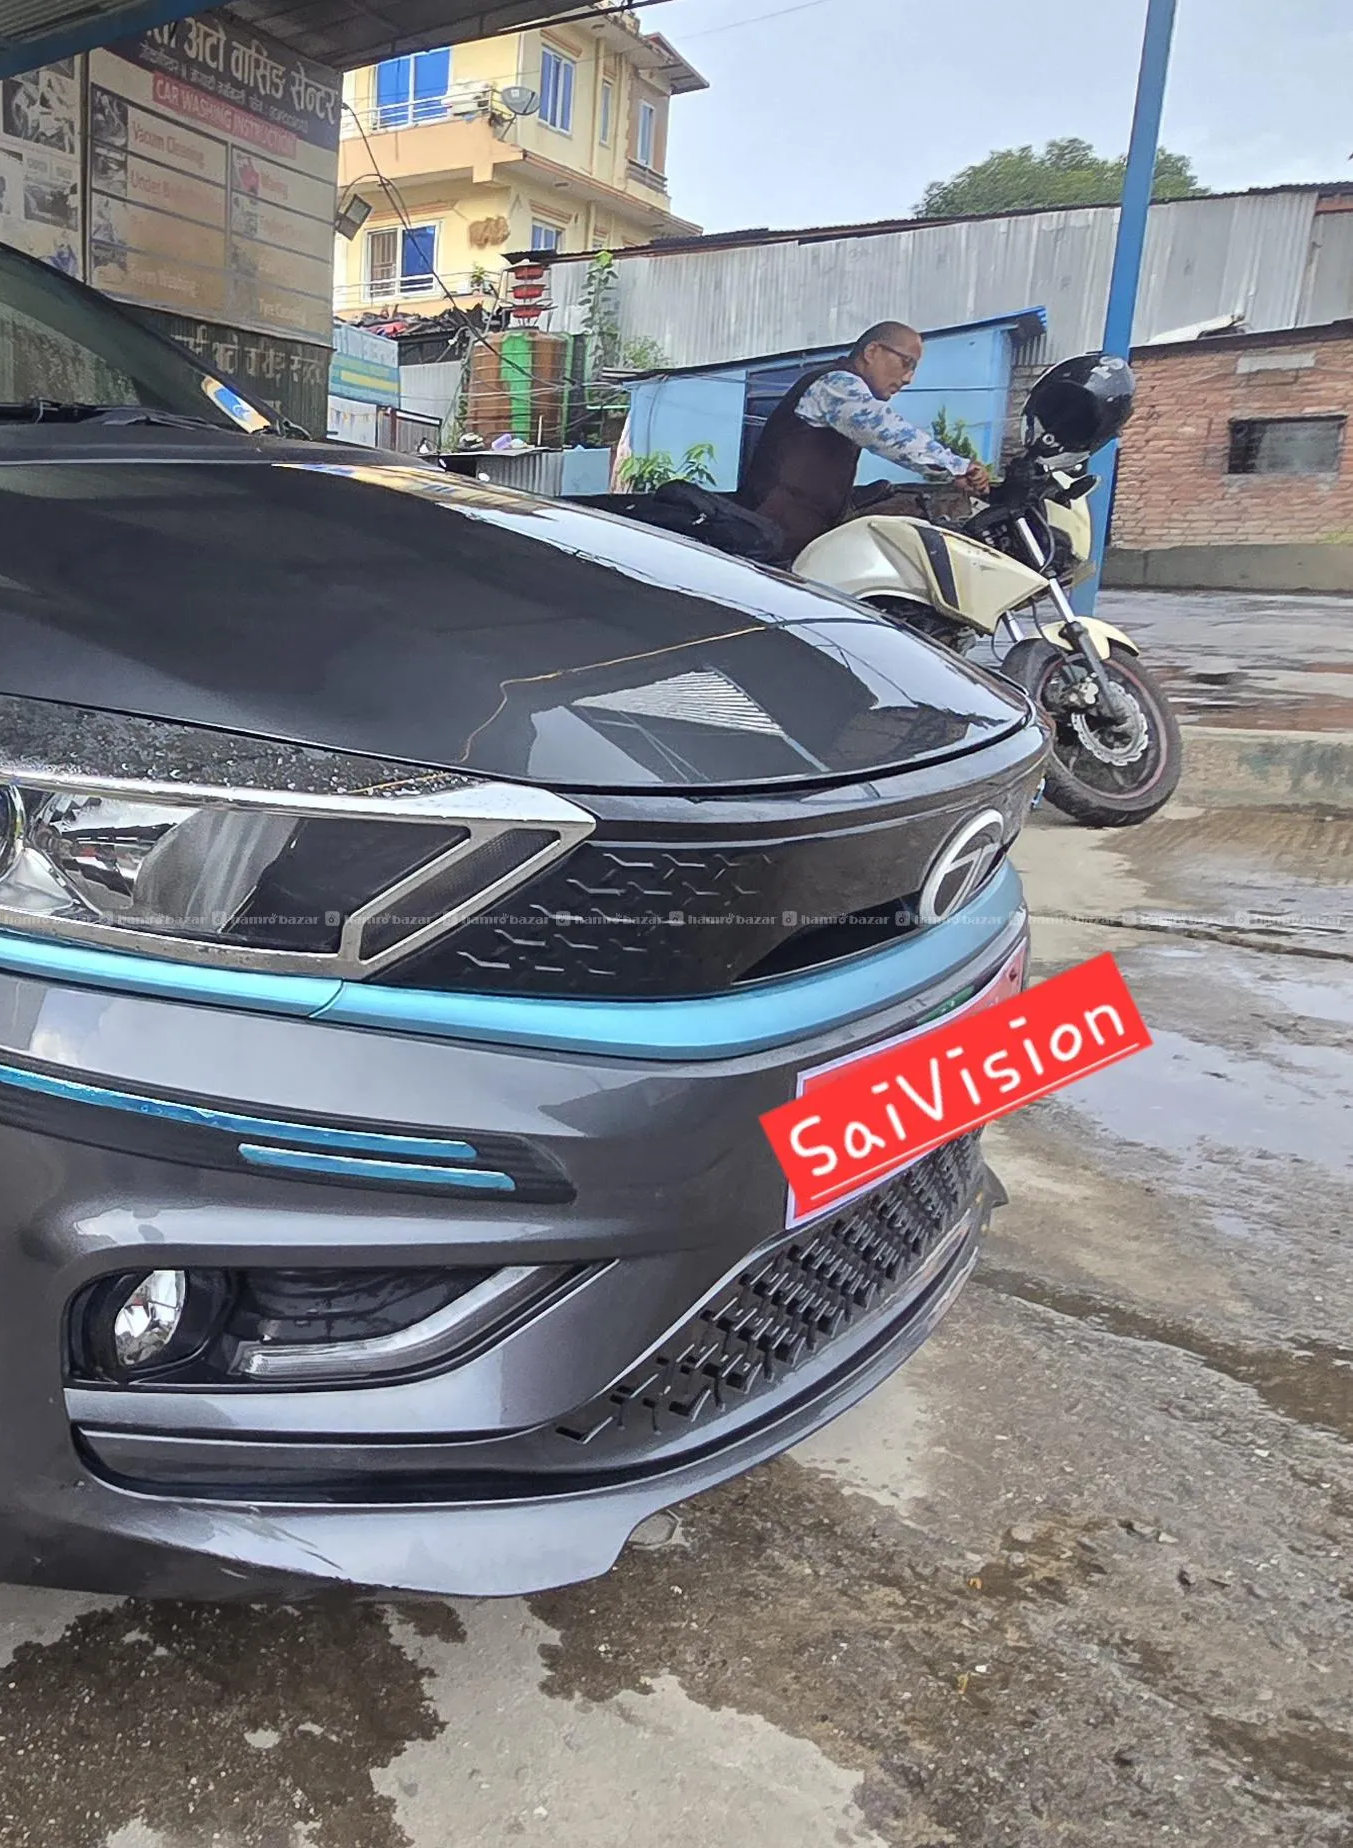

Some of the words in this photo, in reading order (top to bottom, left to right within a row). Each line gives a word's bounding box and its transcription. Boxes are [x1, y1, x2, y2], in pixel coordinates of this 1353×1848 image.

[183, 16, 227, 73] अटो
[155, 79, 180, 107] CAR
[180, 88, 232, 131] WASHING
